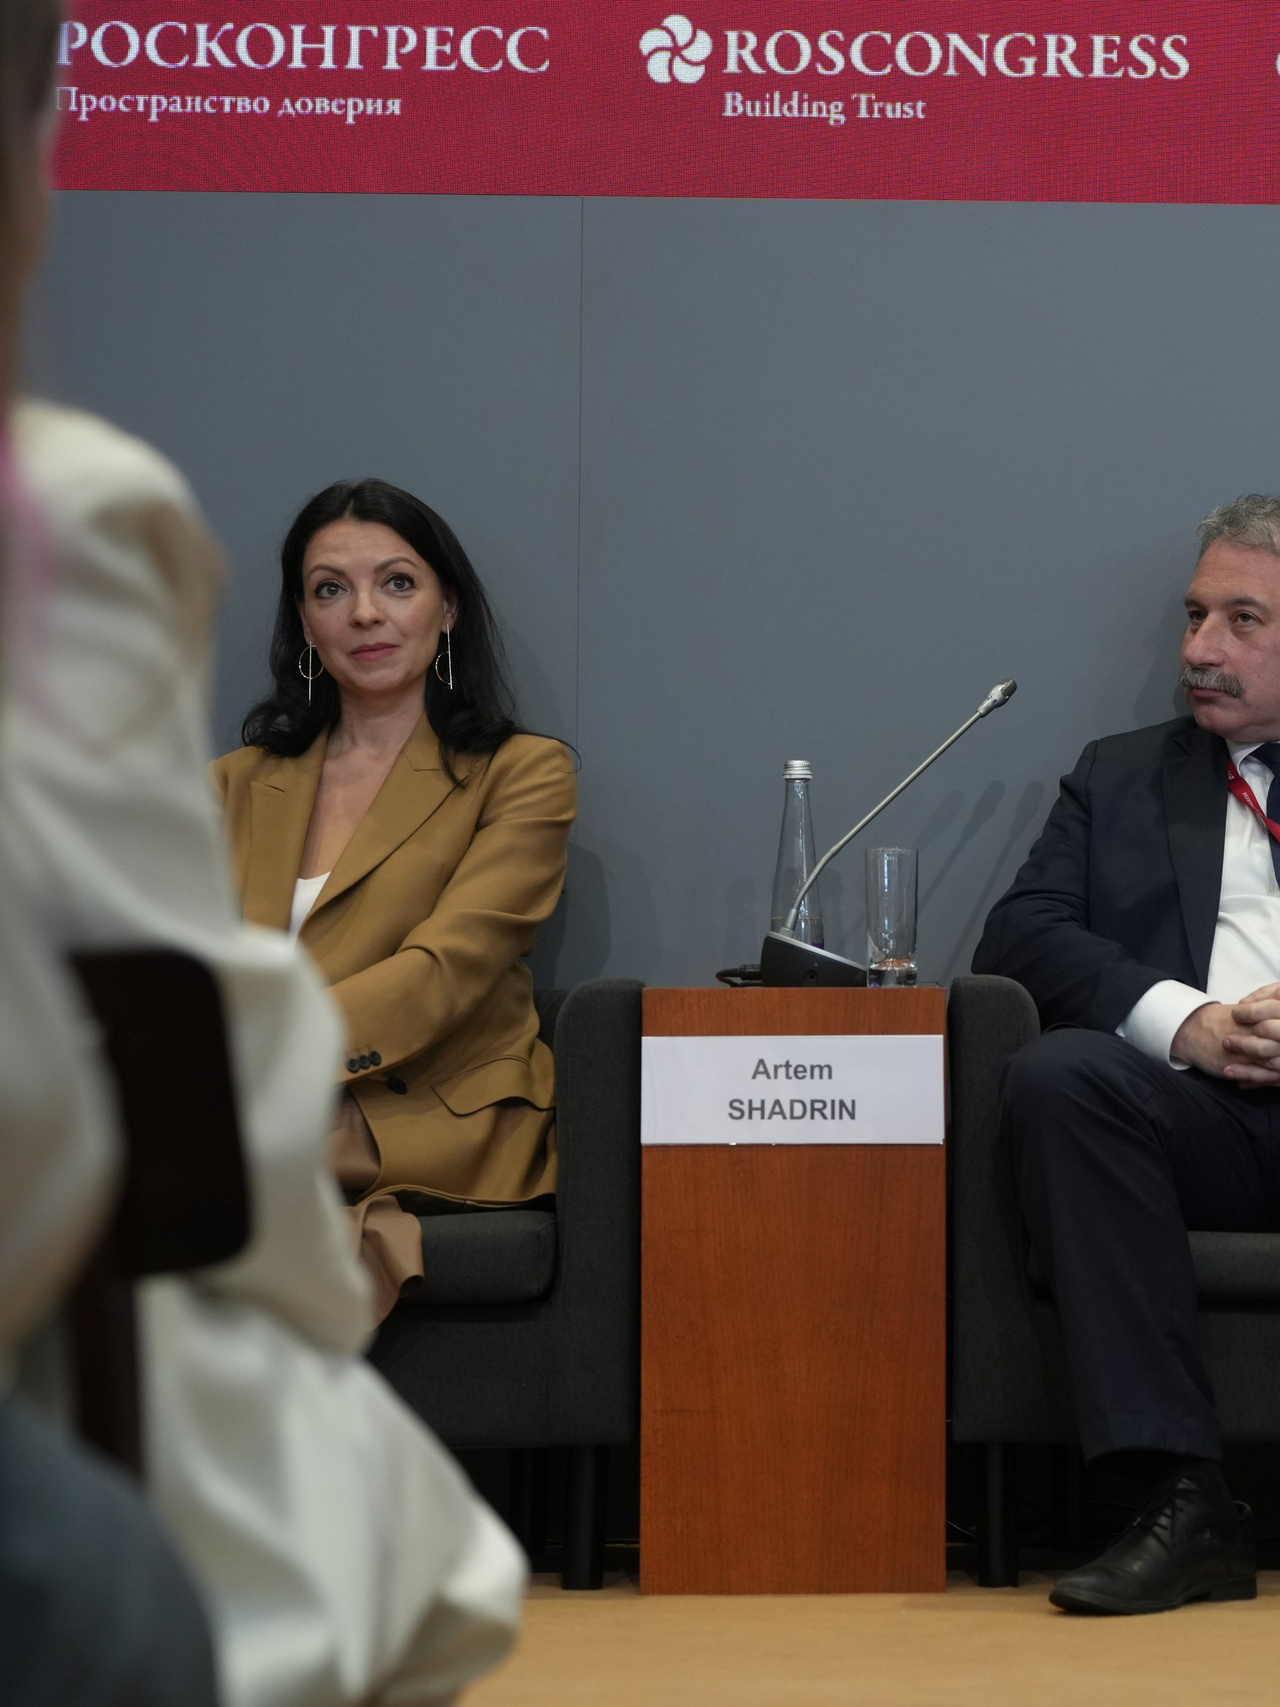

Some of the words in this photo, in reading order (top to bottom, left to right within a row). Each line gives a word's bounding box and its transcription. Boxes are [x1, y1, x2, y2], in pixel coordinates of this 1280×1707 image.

[56, 20, 550, 73] РОСКОНГРЕСС
[722, 29, 1190, 79] ROSCONGRESS
[56, 86, 271, 122] Пространство
[277, 96, 402, 125] доверия
[723, 90, 847, 126] Building
[852, 93, 926, 119] Trust
[751, 1058, 833, 1080] Artem
[728, 1098, 856, 1121] SHADRIN
